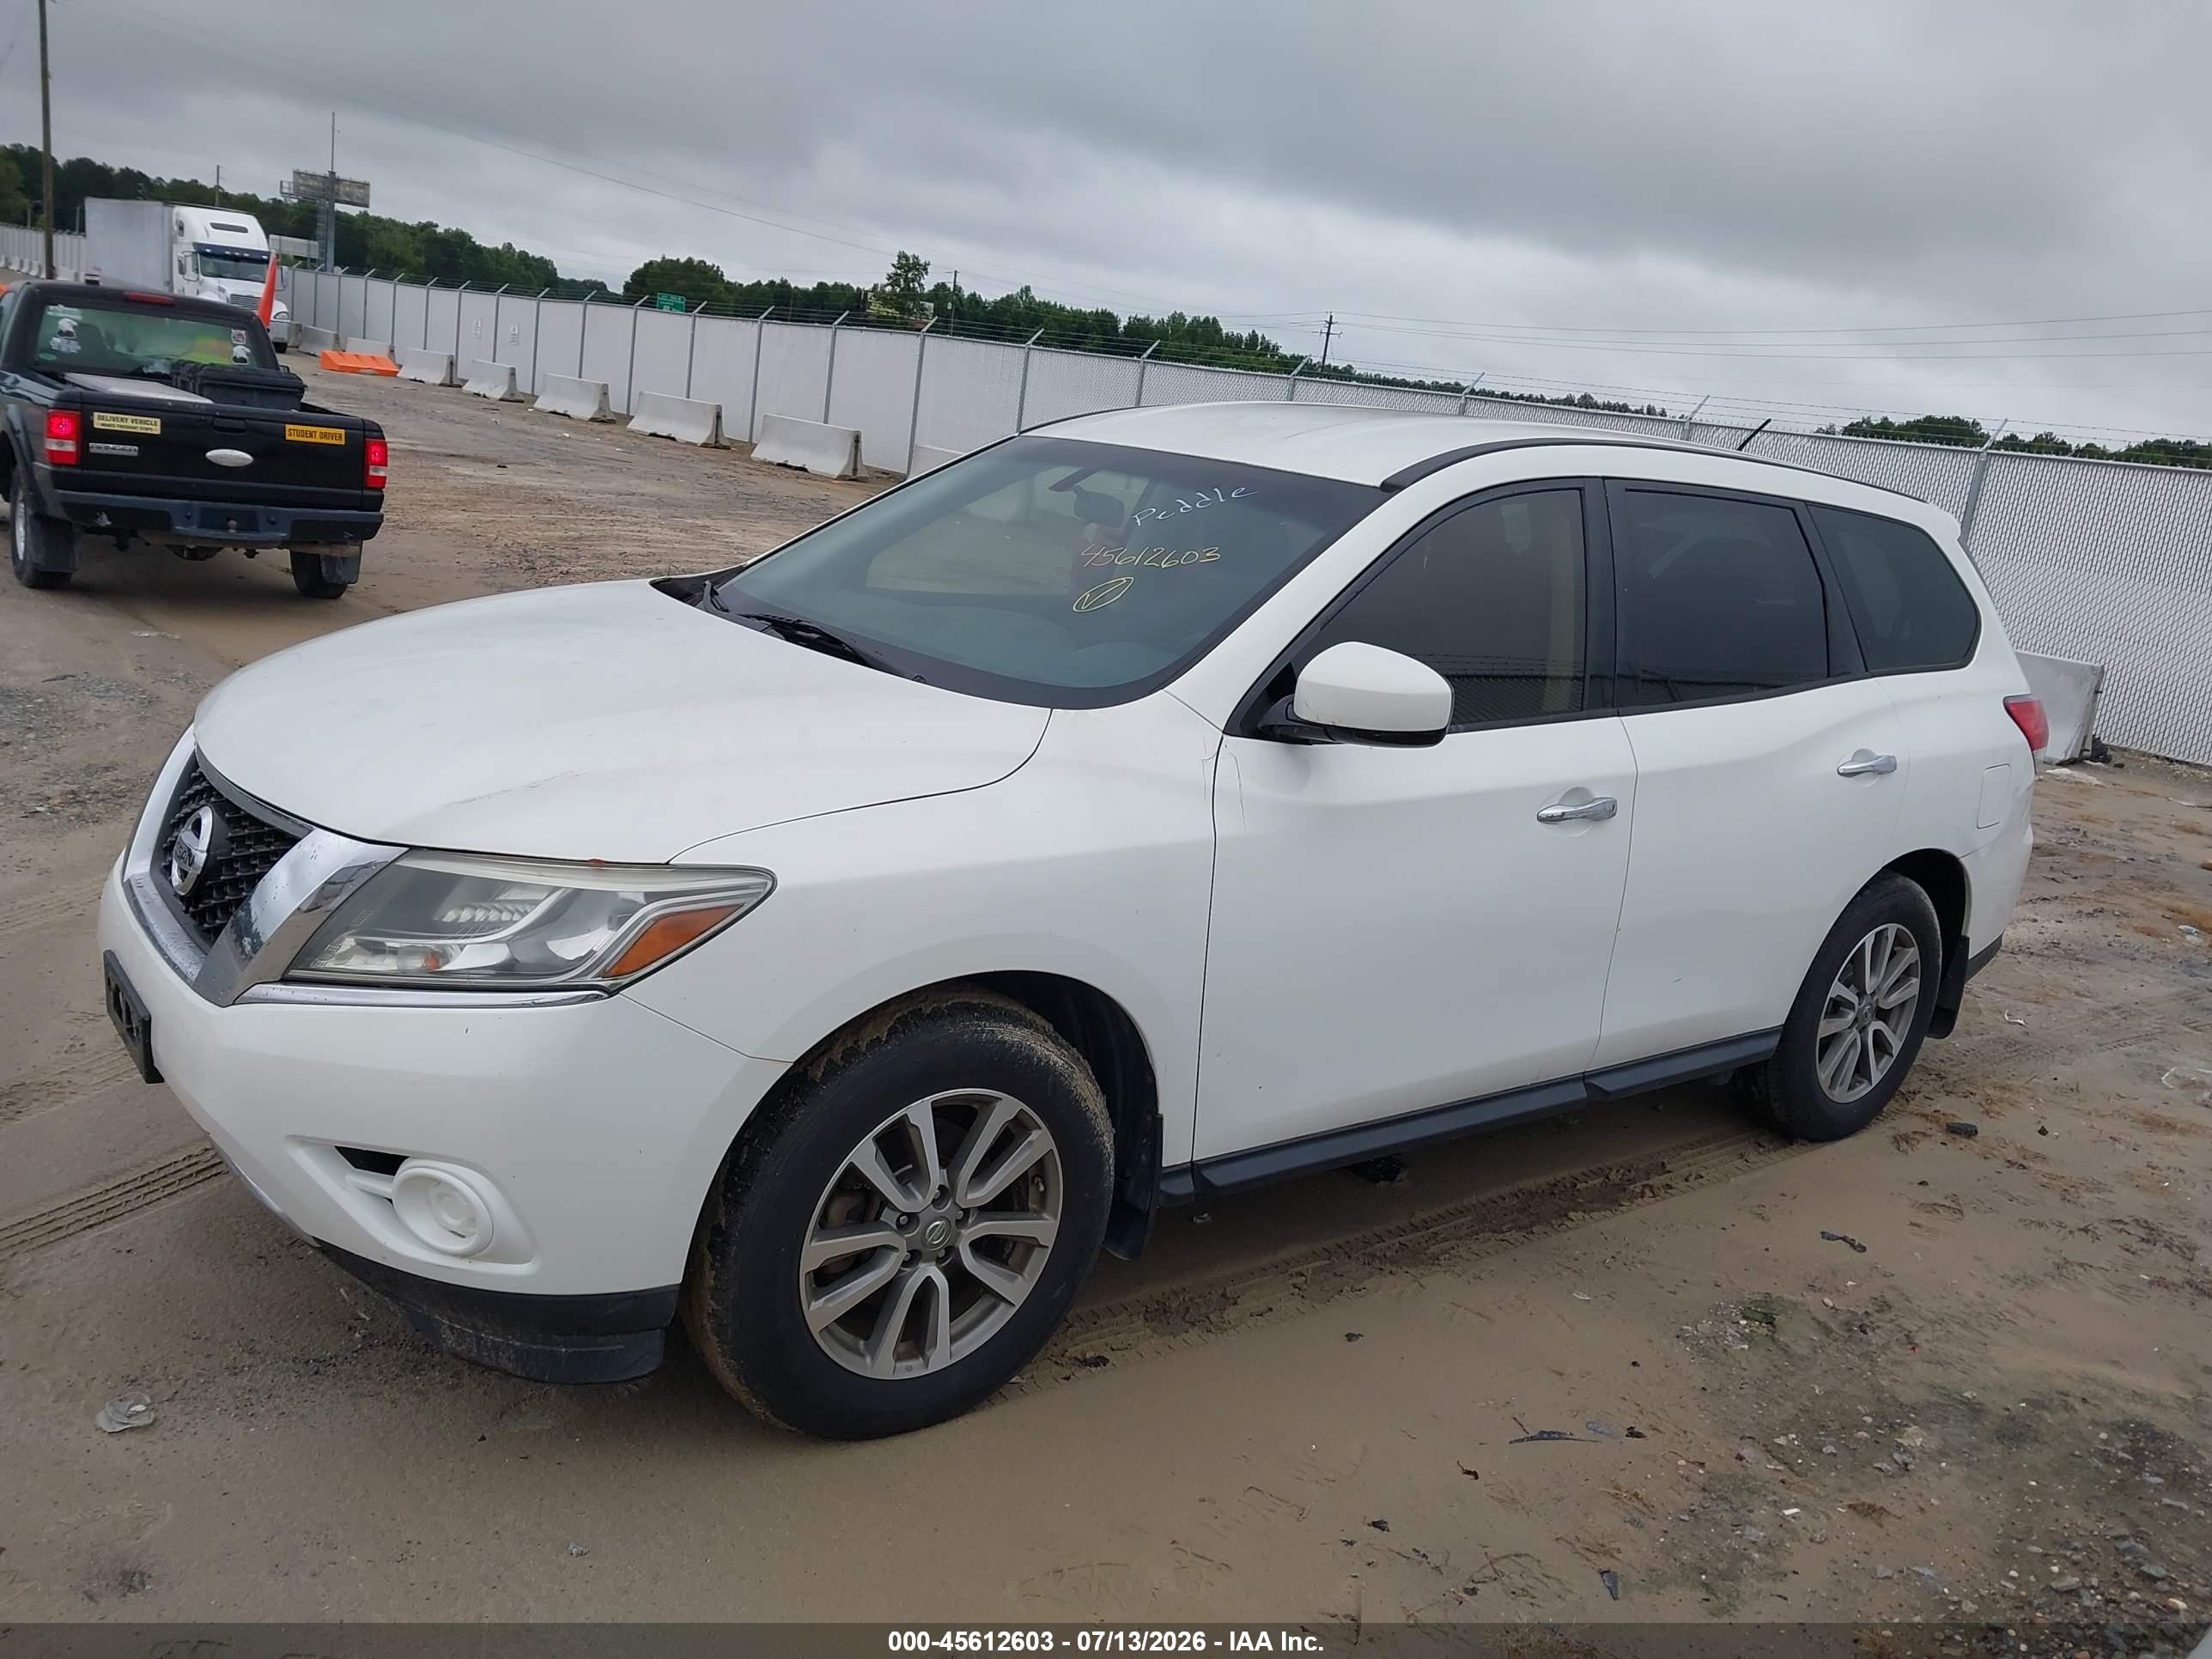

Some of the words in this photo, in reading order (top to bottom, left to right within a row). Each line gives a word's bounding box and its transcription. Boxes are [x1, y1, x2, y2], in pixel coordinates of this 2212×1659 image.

[97, 415, 128, 423] DELIVERY
[288, 428, 318, 440] STUDENT
[319, 431, 343, 441] DRIVER
[1080, 544, 1221, 568] 45612603
